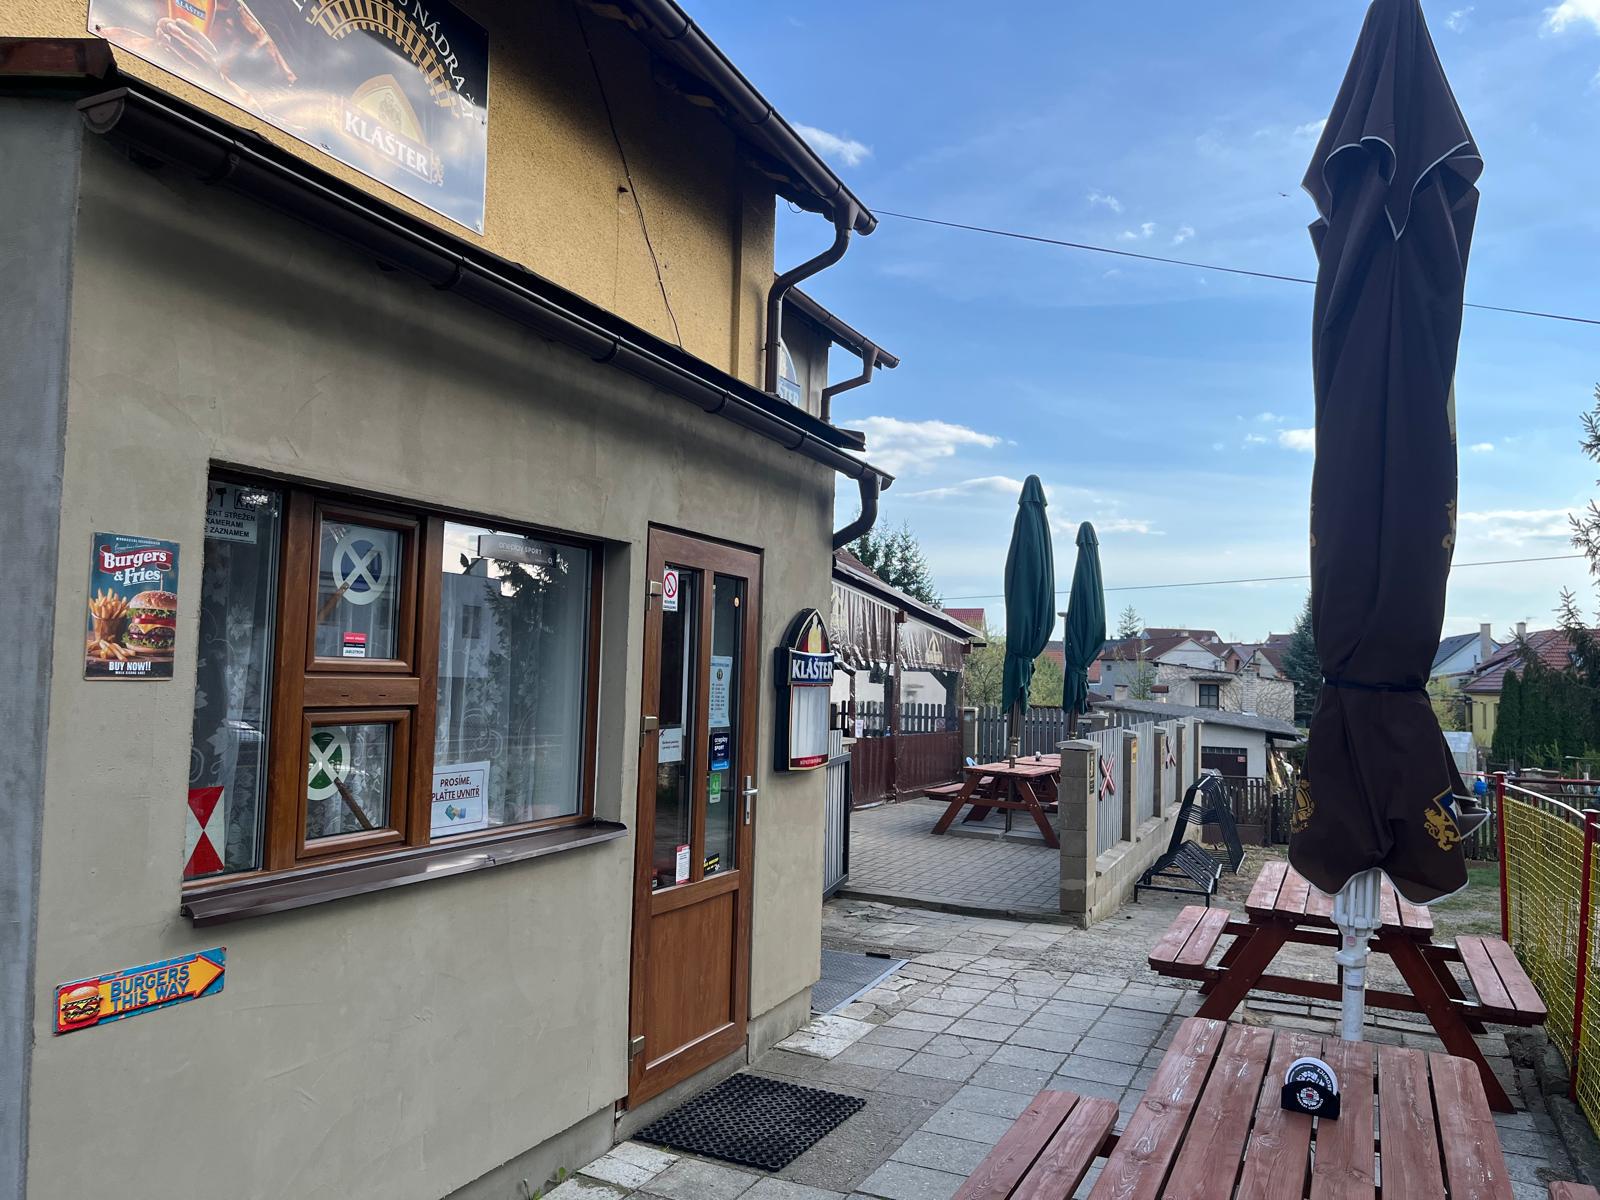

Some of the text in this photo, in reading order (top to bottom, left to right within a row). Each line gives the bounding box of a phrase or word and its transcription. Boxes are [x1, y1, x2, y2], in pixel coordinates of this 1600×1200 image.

[345, 110, 428, 176] KLÁŠTER
[103, 551, 167, 568] Burgers
[525, 547, 543, 556] SPORT
[113, 567, 161, 587] & Fries
[108, 661, 152, 671] BUY NOW!!
[792, 658, 834, 681] KLÁŠTER
[440, 774, 472, 788] PROSÍME,
[432, 785, 480, 801] PLAŤTE UVNITŘ
[110, 965, 189, 997] BURGERS
[110, 979, 189, 1011] THIS WAY
